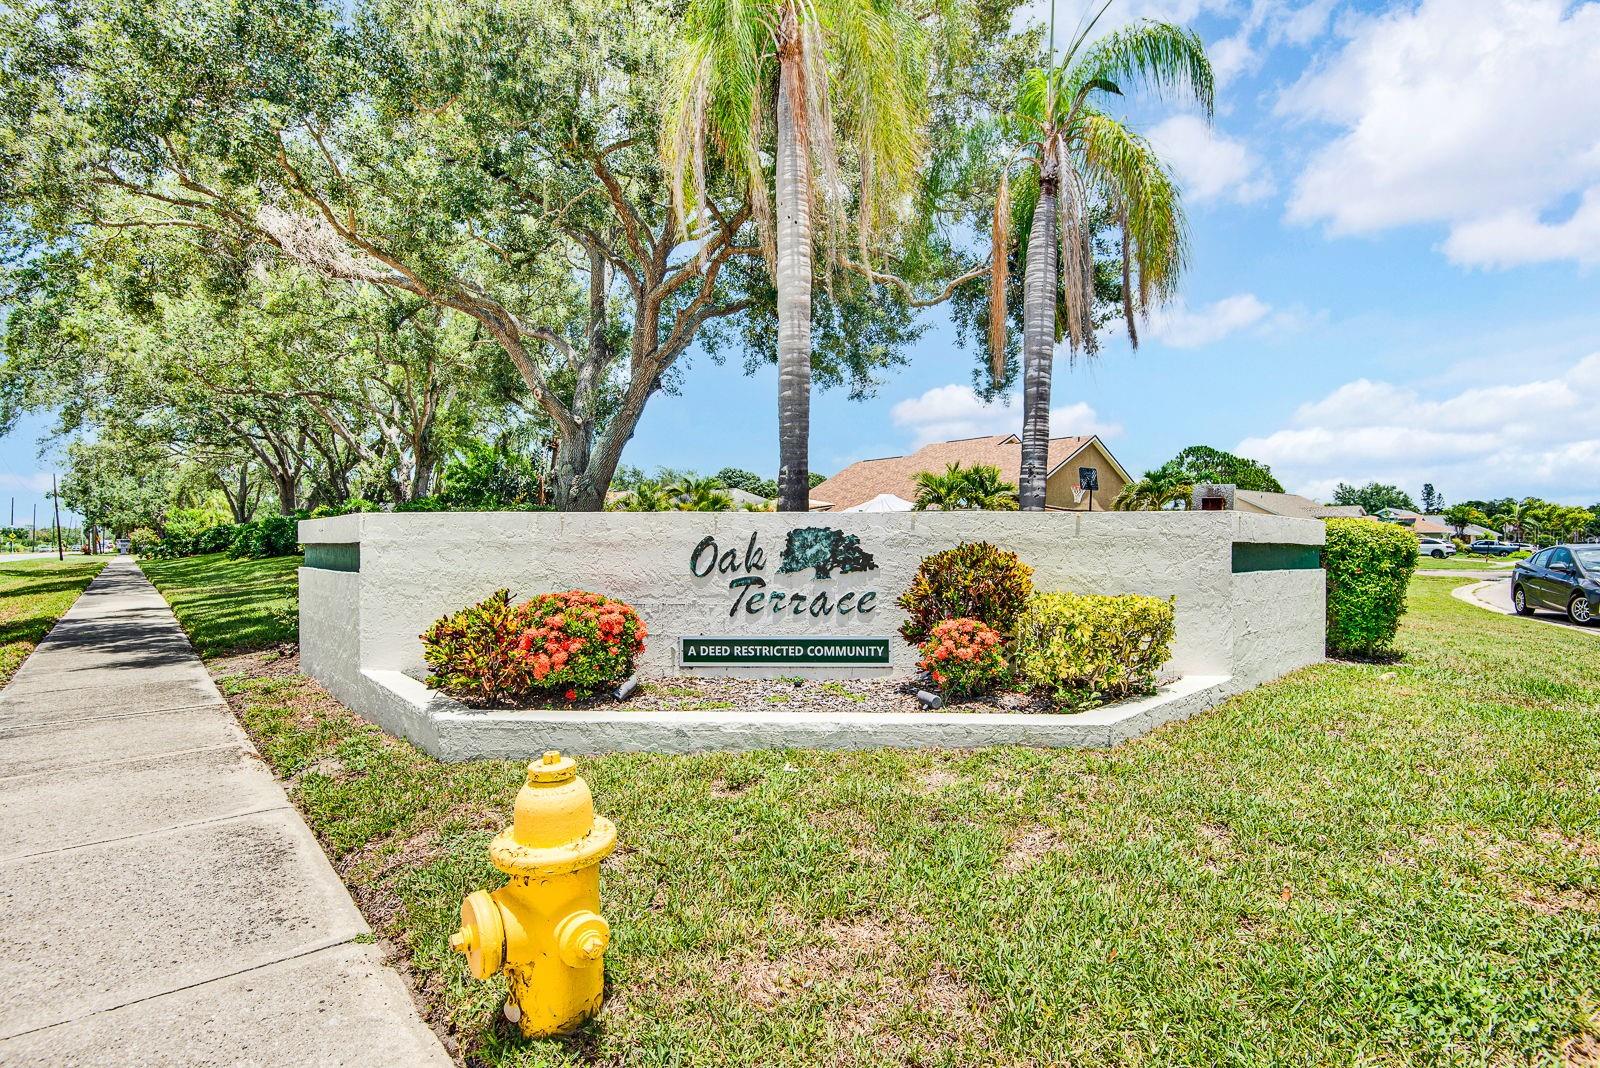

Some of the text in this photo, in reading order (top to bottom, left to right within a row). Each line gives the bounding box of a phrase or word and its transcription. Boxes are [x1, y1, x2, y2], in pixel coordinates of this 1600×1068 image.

[690, 531, 767, 577] Oak
[729, 576, 876, 617] Terrace
[688, 646, 884, 656] A DEED RESTRICTED COMMUNITY
